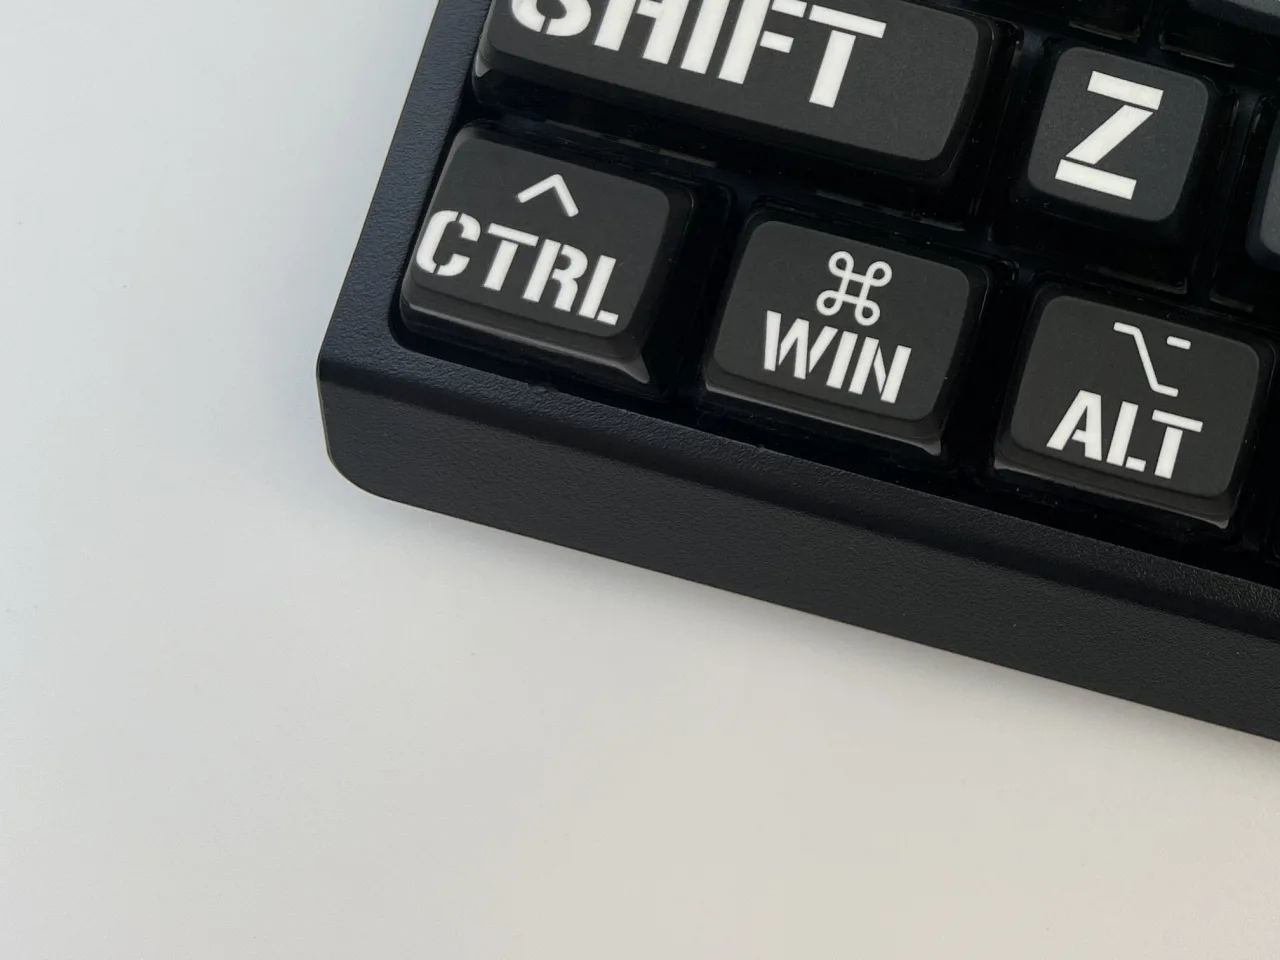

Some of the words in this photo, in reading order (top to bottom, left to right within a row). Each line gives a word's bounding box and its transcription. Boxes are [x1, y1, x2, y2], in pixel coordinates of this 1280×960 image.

[1055, 71, 1163, 200] Z
[414, 209, 620, 327] CTRL
[762, 310, 914, 404] WIN
[1046, 389, 1204, 480] ALT
